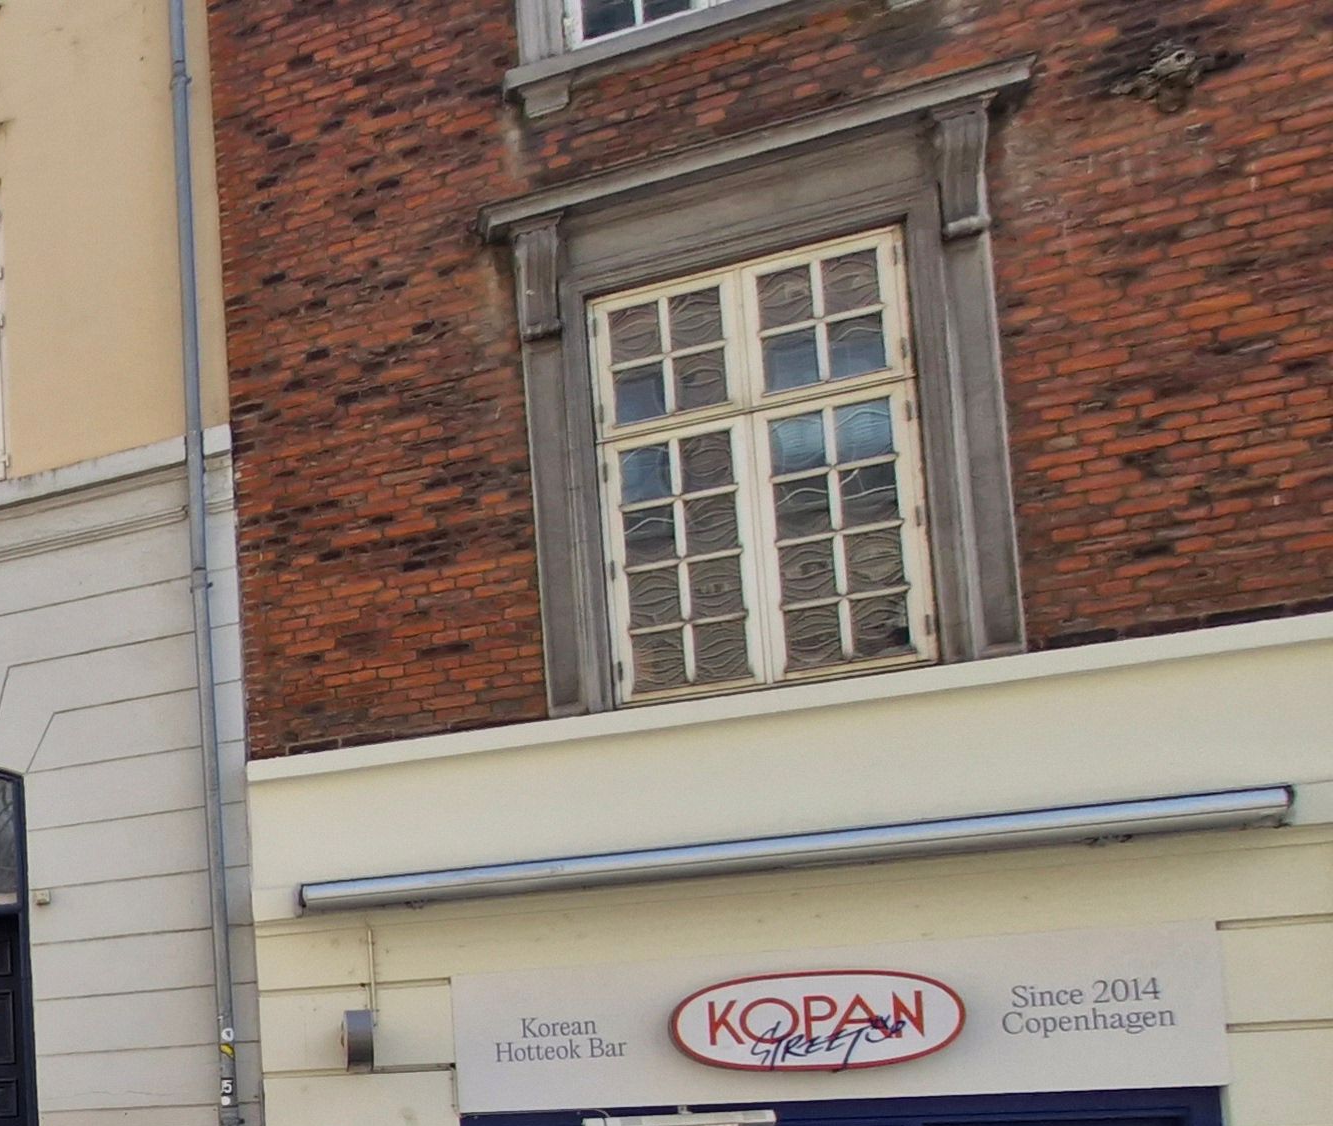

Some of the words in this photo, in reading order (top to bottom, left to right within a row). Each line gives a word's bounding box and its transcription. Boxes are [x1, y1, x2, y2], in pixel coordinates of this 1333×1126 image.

[1011, 985, 1084, 1008] Since
[1092, 976, 1162, 1004] 2014
[520, 1017, 597, 1038] Korean
[707, 989, 925, 1046] KOPAN
[1001, 1007, 1176, 1038] Copenhagen
[495, 1039, 581, 1062] Hotteok
[589, 1037, 628, 1058] Bar
[750, 1021, 874, 1072] STREET
